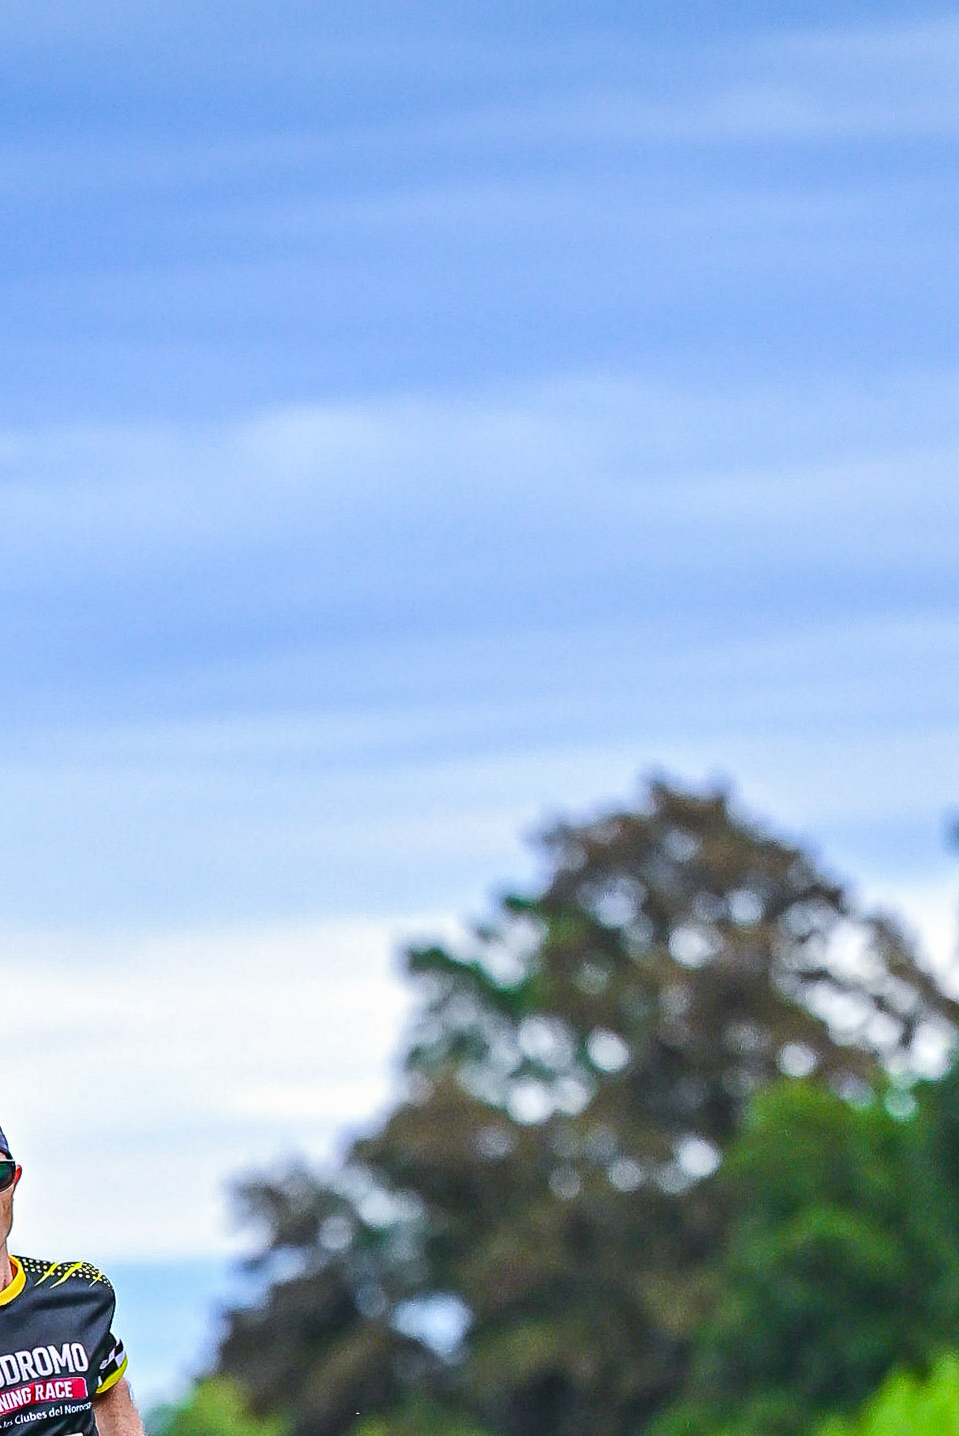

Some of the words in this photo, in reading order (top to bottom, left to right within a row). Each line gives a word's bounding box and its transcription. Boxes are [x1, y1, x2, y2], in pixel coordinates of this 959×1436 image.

[34, 1381, 73, 1401] RACE
[14, 1411, 47, 1424] Clubes
[48, 1405, 63, 1418] del
[64, 1401, 92, 1415] Noroest
